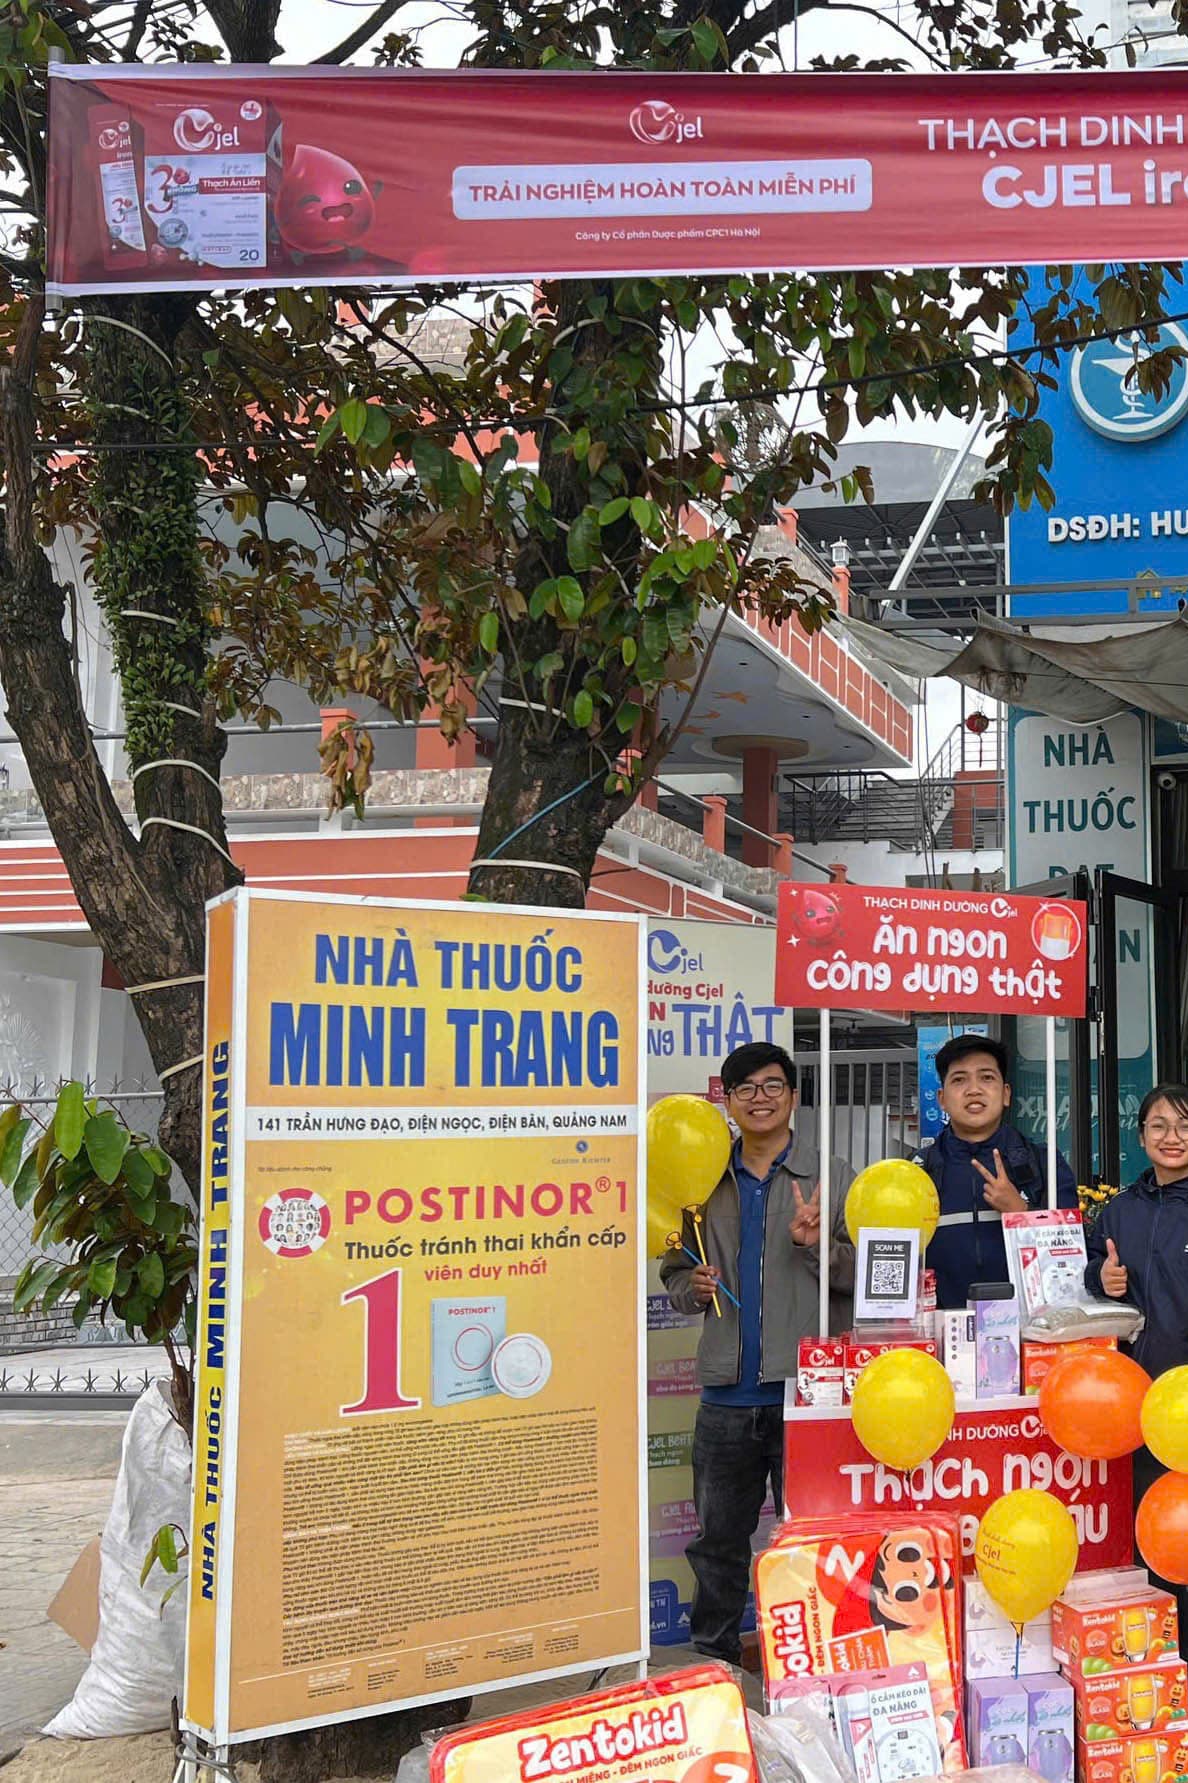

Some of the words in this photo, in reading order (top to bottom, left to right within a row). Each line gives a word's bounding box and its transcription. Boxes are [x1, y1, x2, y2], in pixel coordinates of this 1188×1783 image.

[919, 117, 1067, 158] THẠCH
[1081, 114, 1184, 146] DINH
[470, 180, 521, 203] TRẢI
[526, 178, 612, 204] NGHIỆM
[620, 178, 685, 199] HOÀN
[691, 176, 754, 197] TOÀN
[758, 172, 813, 195] MIỄN
[820, 174, 856, 194] PHÍ
[982, 164, 1131, 208] CJEL
[239, 249, 260, 262] 20
[1048, 515, 1141, 544] DSĐH:
[1044, 726, 1114, 767] NHÀ
[1023, 787, 1136, 833] THUỐC
[864, 896, 907, 918] THẠCH
[911, 899, 941, 912] DINH
[873, 914, 917, 955] Ăn
[927, 924, 1007, 960] ngon
[315, 928, 419, 988] NHÀ
[435, 928, 582, 993] THUỐC
[903, 962, 979, 1002] dụng
[989, 959, 1063, 1005] thật
[695, 982, 724, 1001] Cjel
[269, 1002, 426, 1087] MINH
[447, 1008, 619, 1088] TRANG
[211, 1040, 230, 1211] TRANG
[258, 1118, 281, 1131] 141
[327, 1116, 366, 1131] HƯNG
[370, 1117, 404, 1134] ĐẠO,
[408, 1114, 437, 1134] ĐIỆN
[441, 1116, 485, 1133] NGỌC,
[489, 1113, 517, 1132] ĐIỆN
[600, 1115, 627, 1128] NAM
[345, 1235, 413, 1260] Thuốc
[421, 1235, 477, 1257] tránh
[483, 1233, 524, 1254] thai
[530, 1225, 581, 1250] khẩn
[587, 1225, 627, 1251] cấp
[875, 1244, 893, 1252] SCAN
[895, 1244, 905, 1252] ME
[425, 1263, 463, 1282] viên
[469, 1263, 502, 1283] duy
[508, 1256, 548, 1277] nhất
[206, 1229, 228, 1368] MINH
[339, 1267, 422, 1418] 1
[205, 1385, 222, 1507] THUỐC
[839, 1457, 989, 1511] Thạch
[201, 1521, 217, 1600] NHÀ
[521, 1704, 687, 1779] Zentokid
[620, 1761, 643, 1776] ĐÊM
[645, 1754, 676, 1770] NGON
